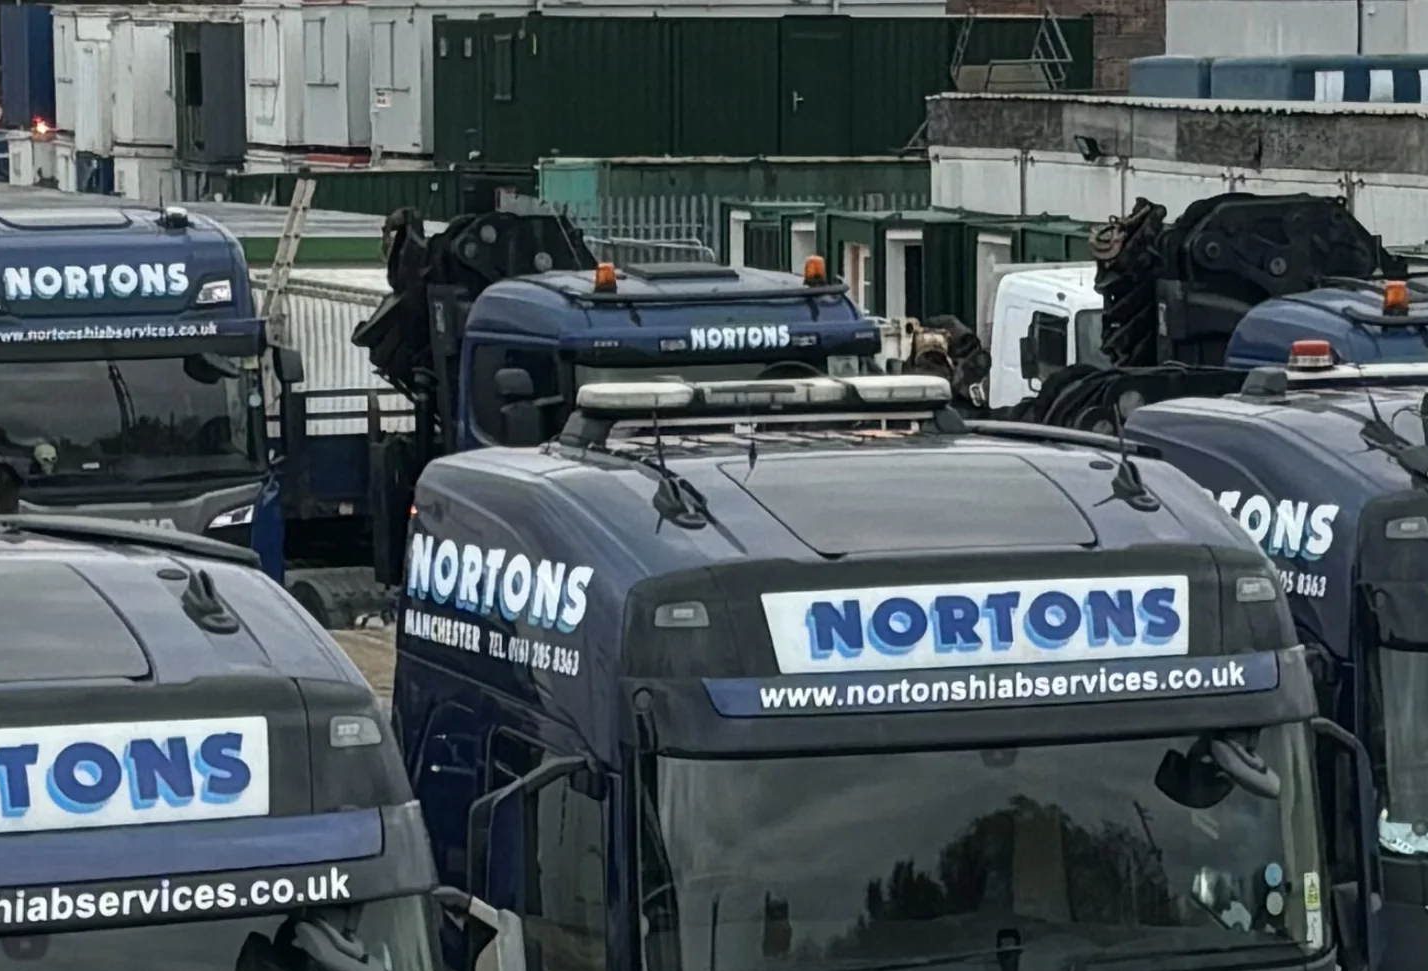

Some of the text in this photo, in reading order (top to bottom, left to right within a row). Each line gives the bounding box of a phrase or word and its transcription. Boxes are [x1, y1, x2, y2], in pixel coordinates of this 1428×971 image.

[3, 263, 189, 300] NORTONS
[690, 325, 790, 351] NORTONS
[407, 533, 594, 634] NORTONS
[405, 608, 481, 653] MANCHESTER
[552, 646, 580, 676] 8363
[806, 587, 1182, 660] NORTONS
[760, 660, 1246, 708] www.nortonshiabservices.co.uk
